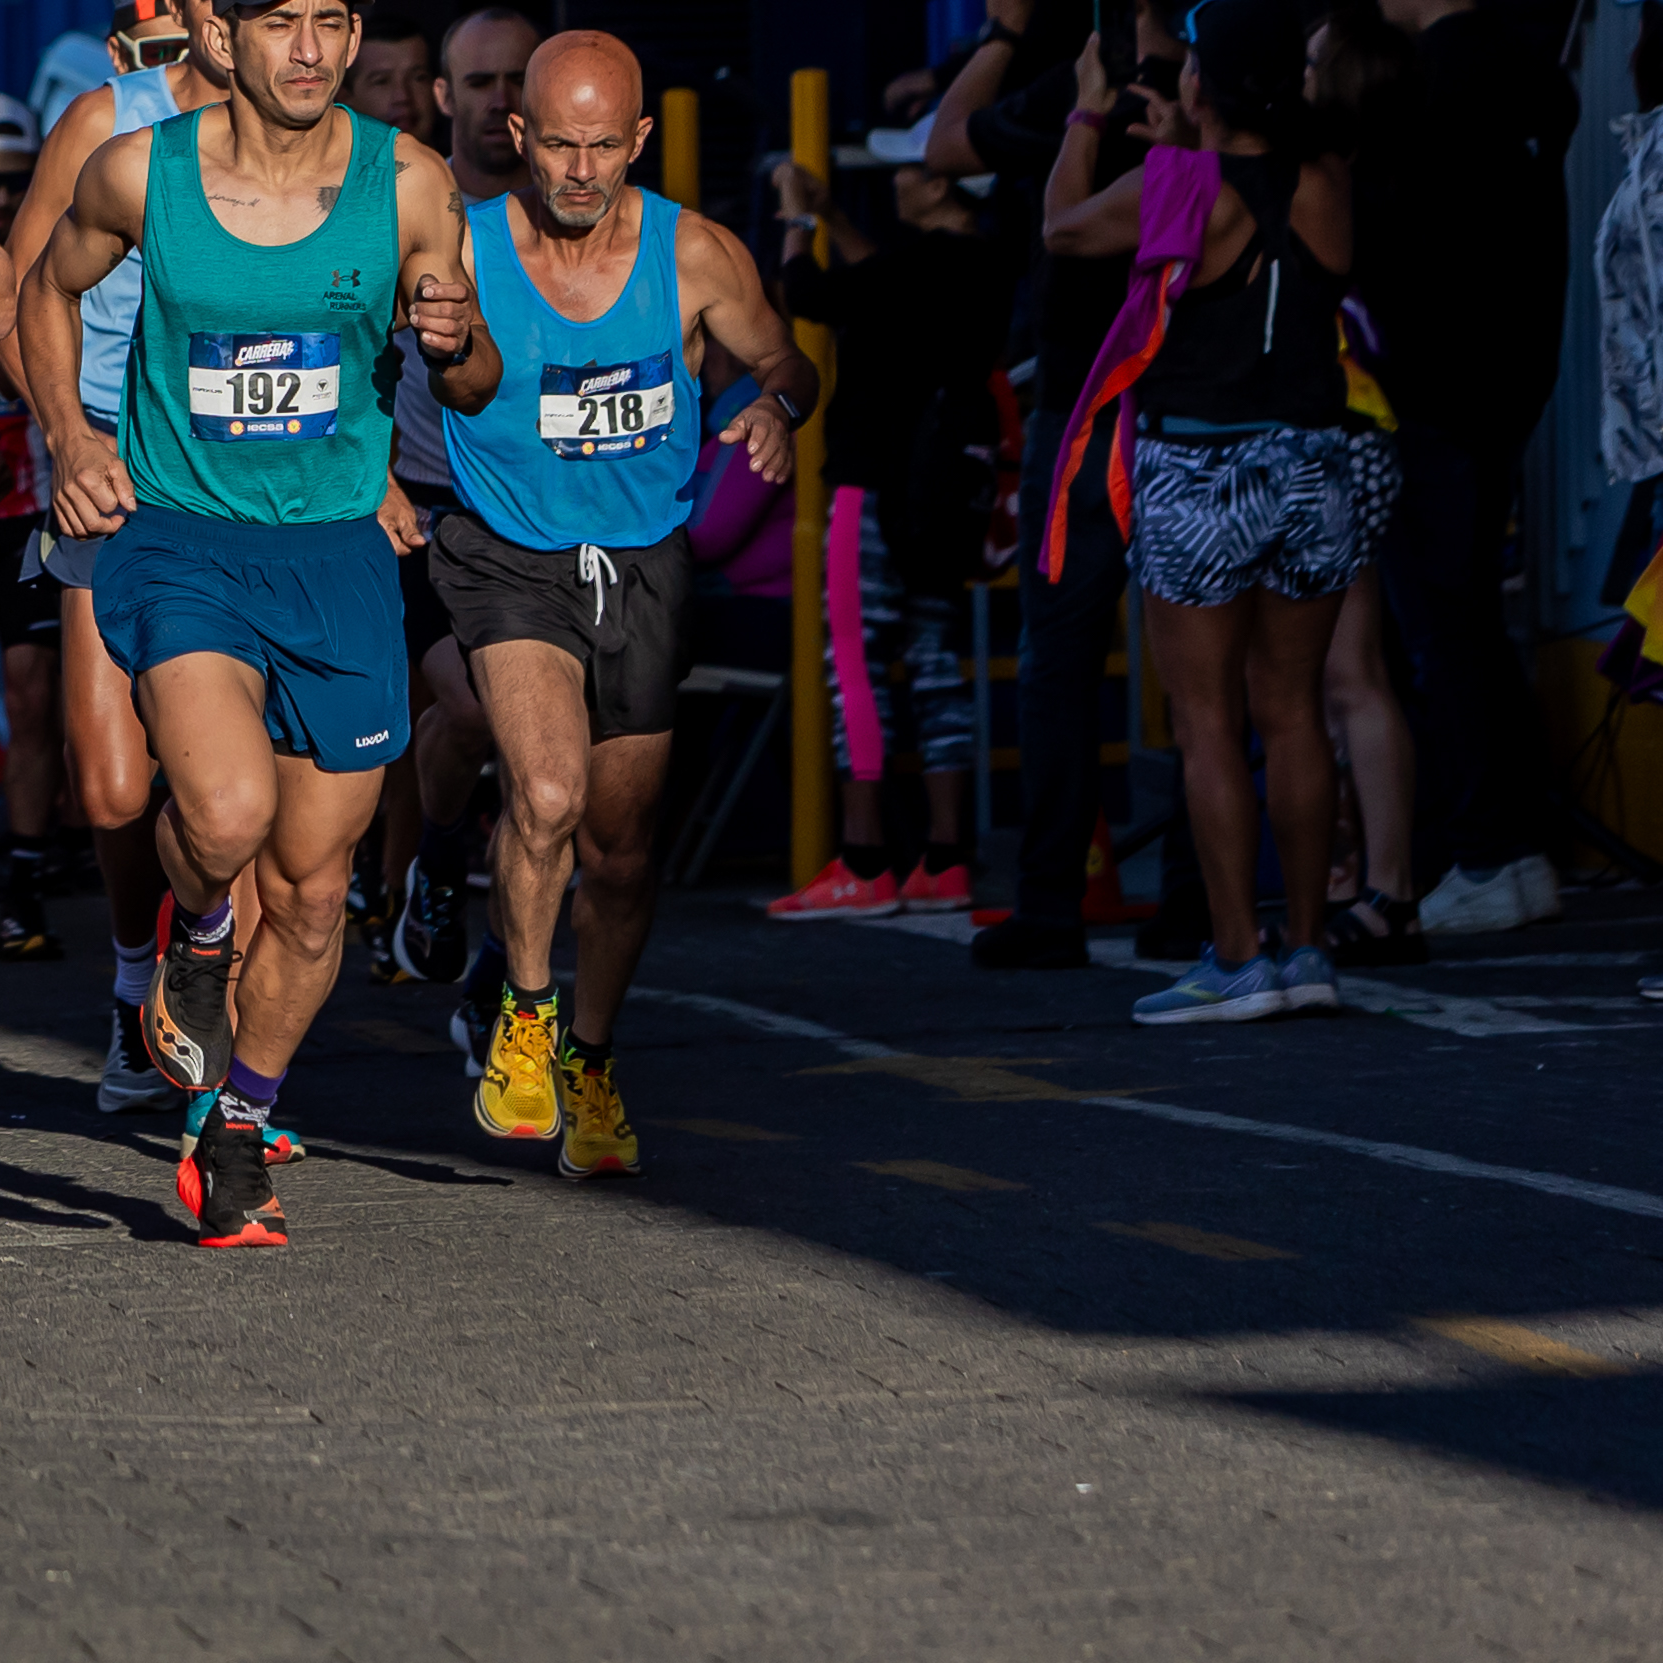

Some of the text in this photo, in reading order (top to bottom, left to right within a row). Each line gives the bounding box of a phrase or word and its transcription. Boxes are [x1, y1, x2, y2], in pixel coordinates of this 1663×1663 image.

[237, 340, 292, 362] CARRERA
[226, 372, 301, 415] 192
[577, 392, 645, 437] 218
